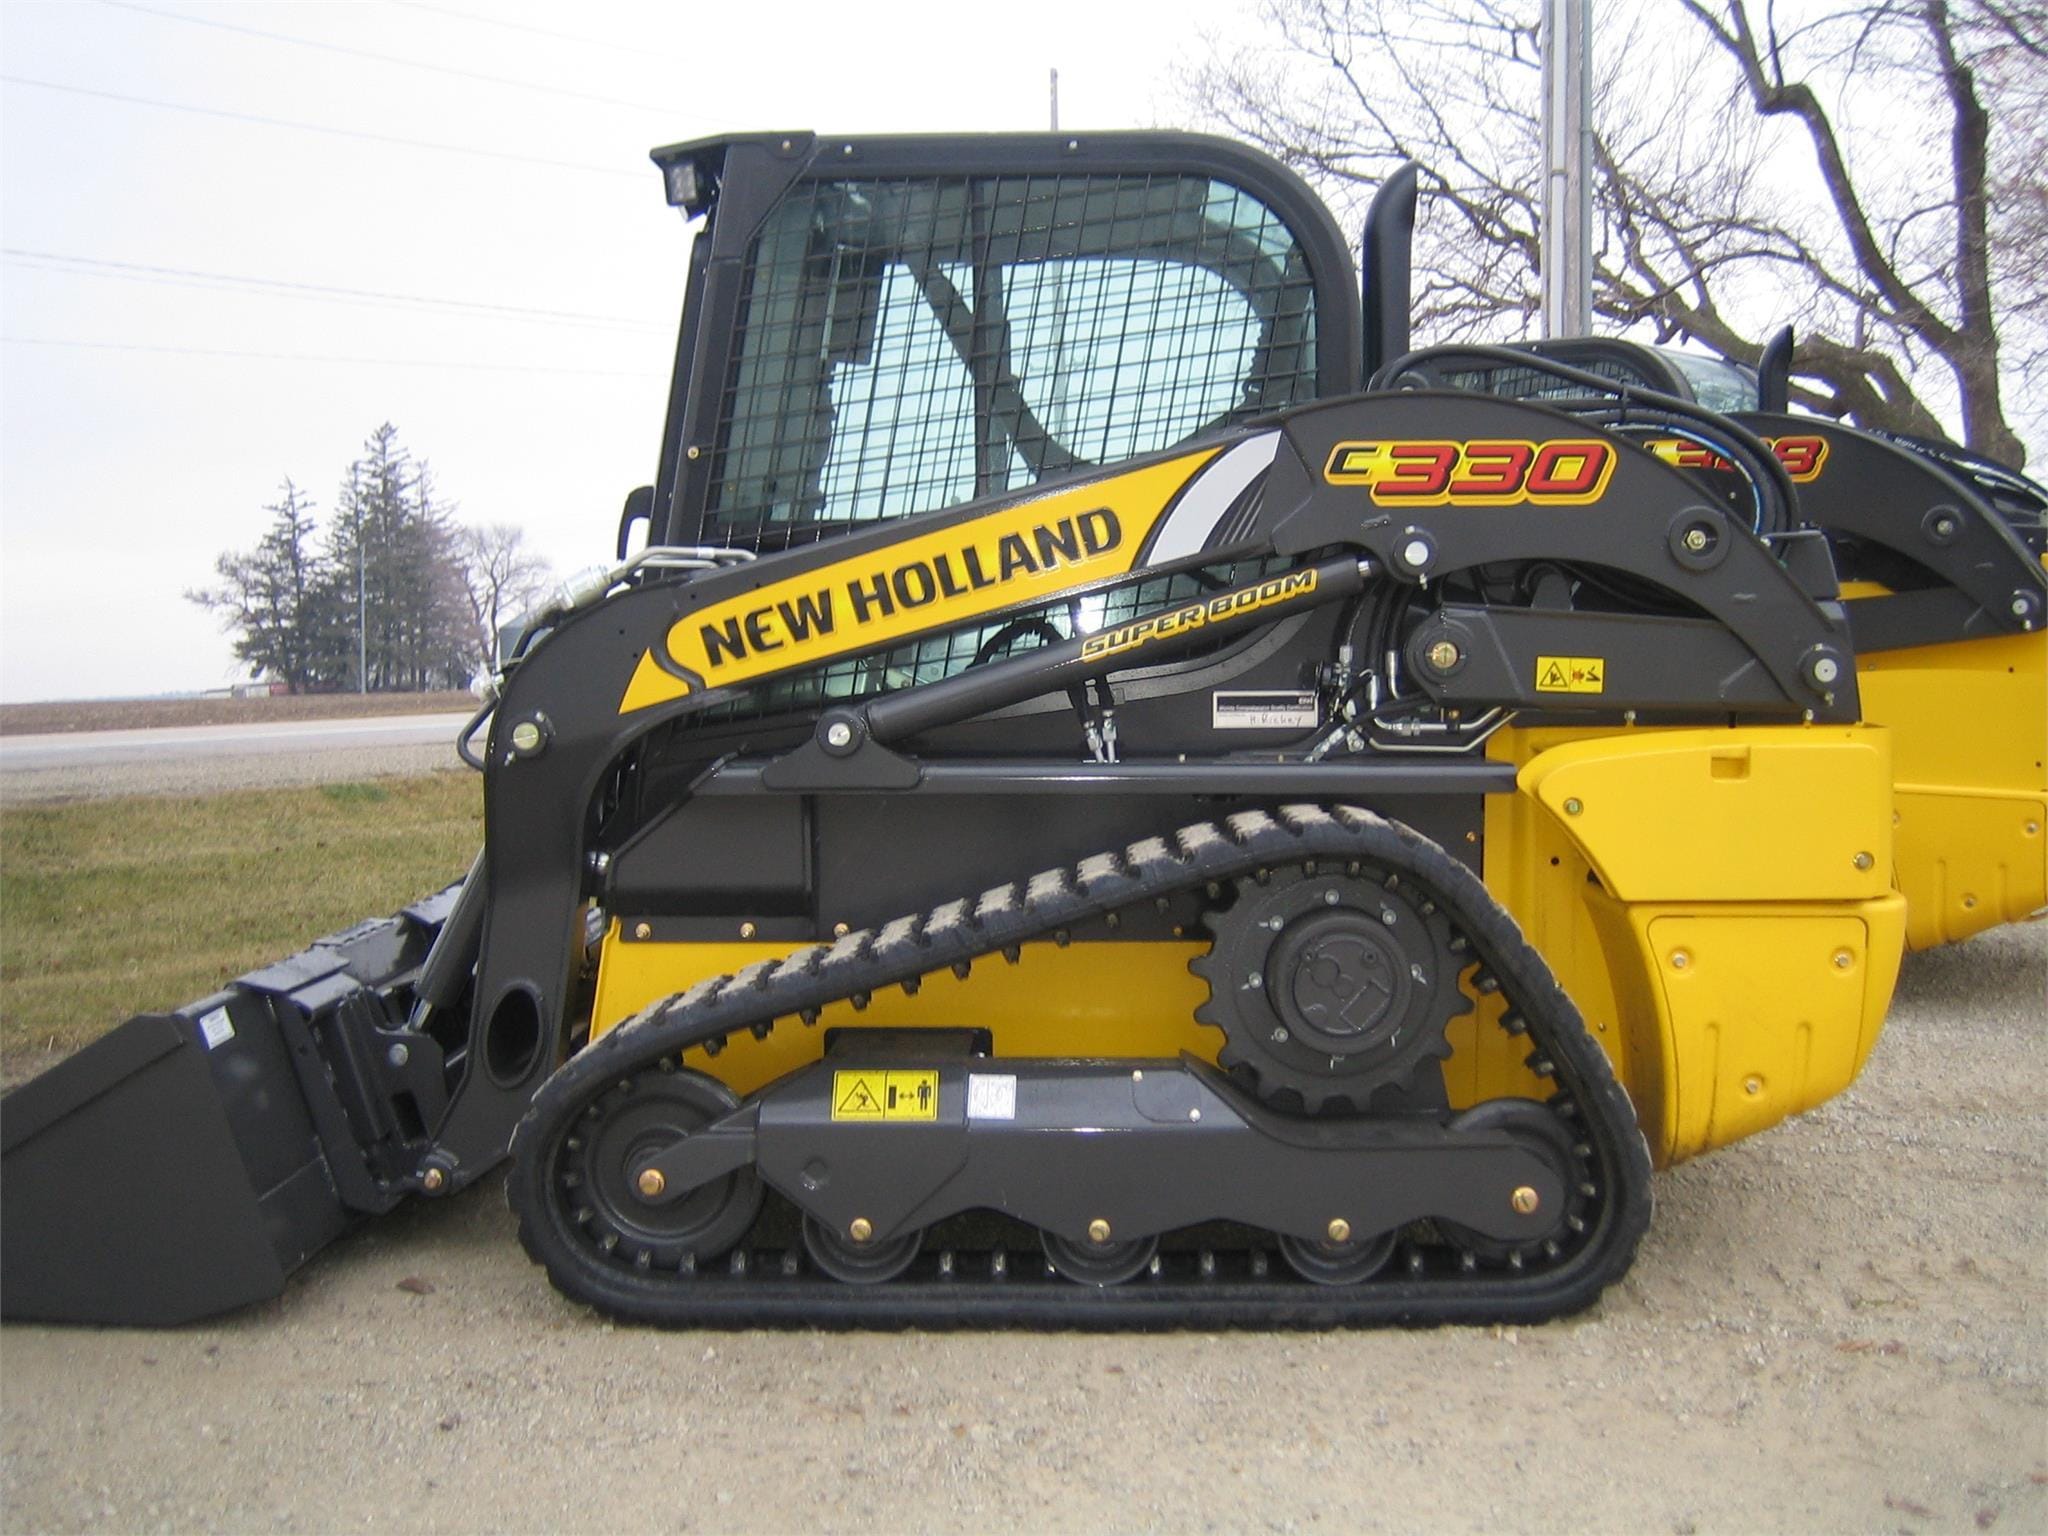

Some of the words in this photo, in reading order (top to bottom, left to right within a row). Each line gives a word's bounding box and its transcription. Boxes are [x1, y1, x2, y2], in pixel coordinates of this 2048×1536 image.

[1325, 441, 1616, 505] C330
[699, 588, 836, 668] NEW
[846, 506, 1123, 624] HOLLAND
[1083, 605, 1204, 662] SUPER
[1209, 569, 1318, 621] BOOM
